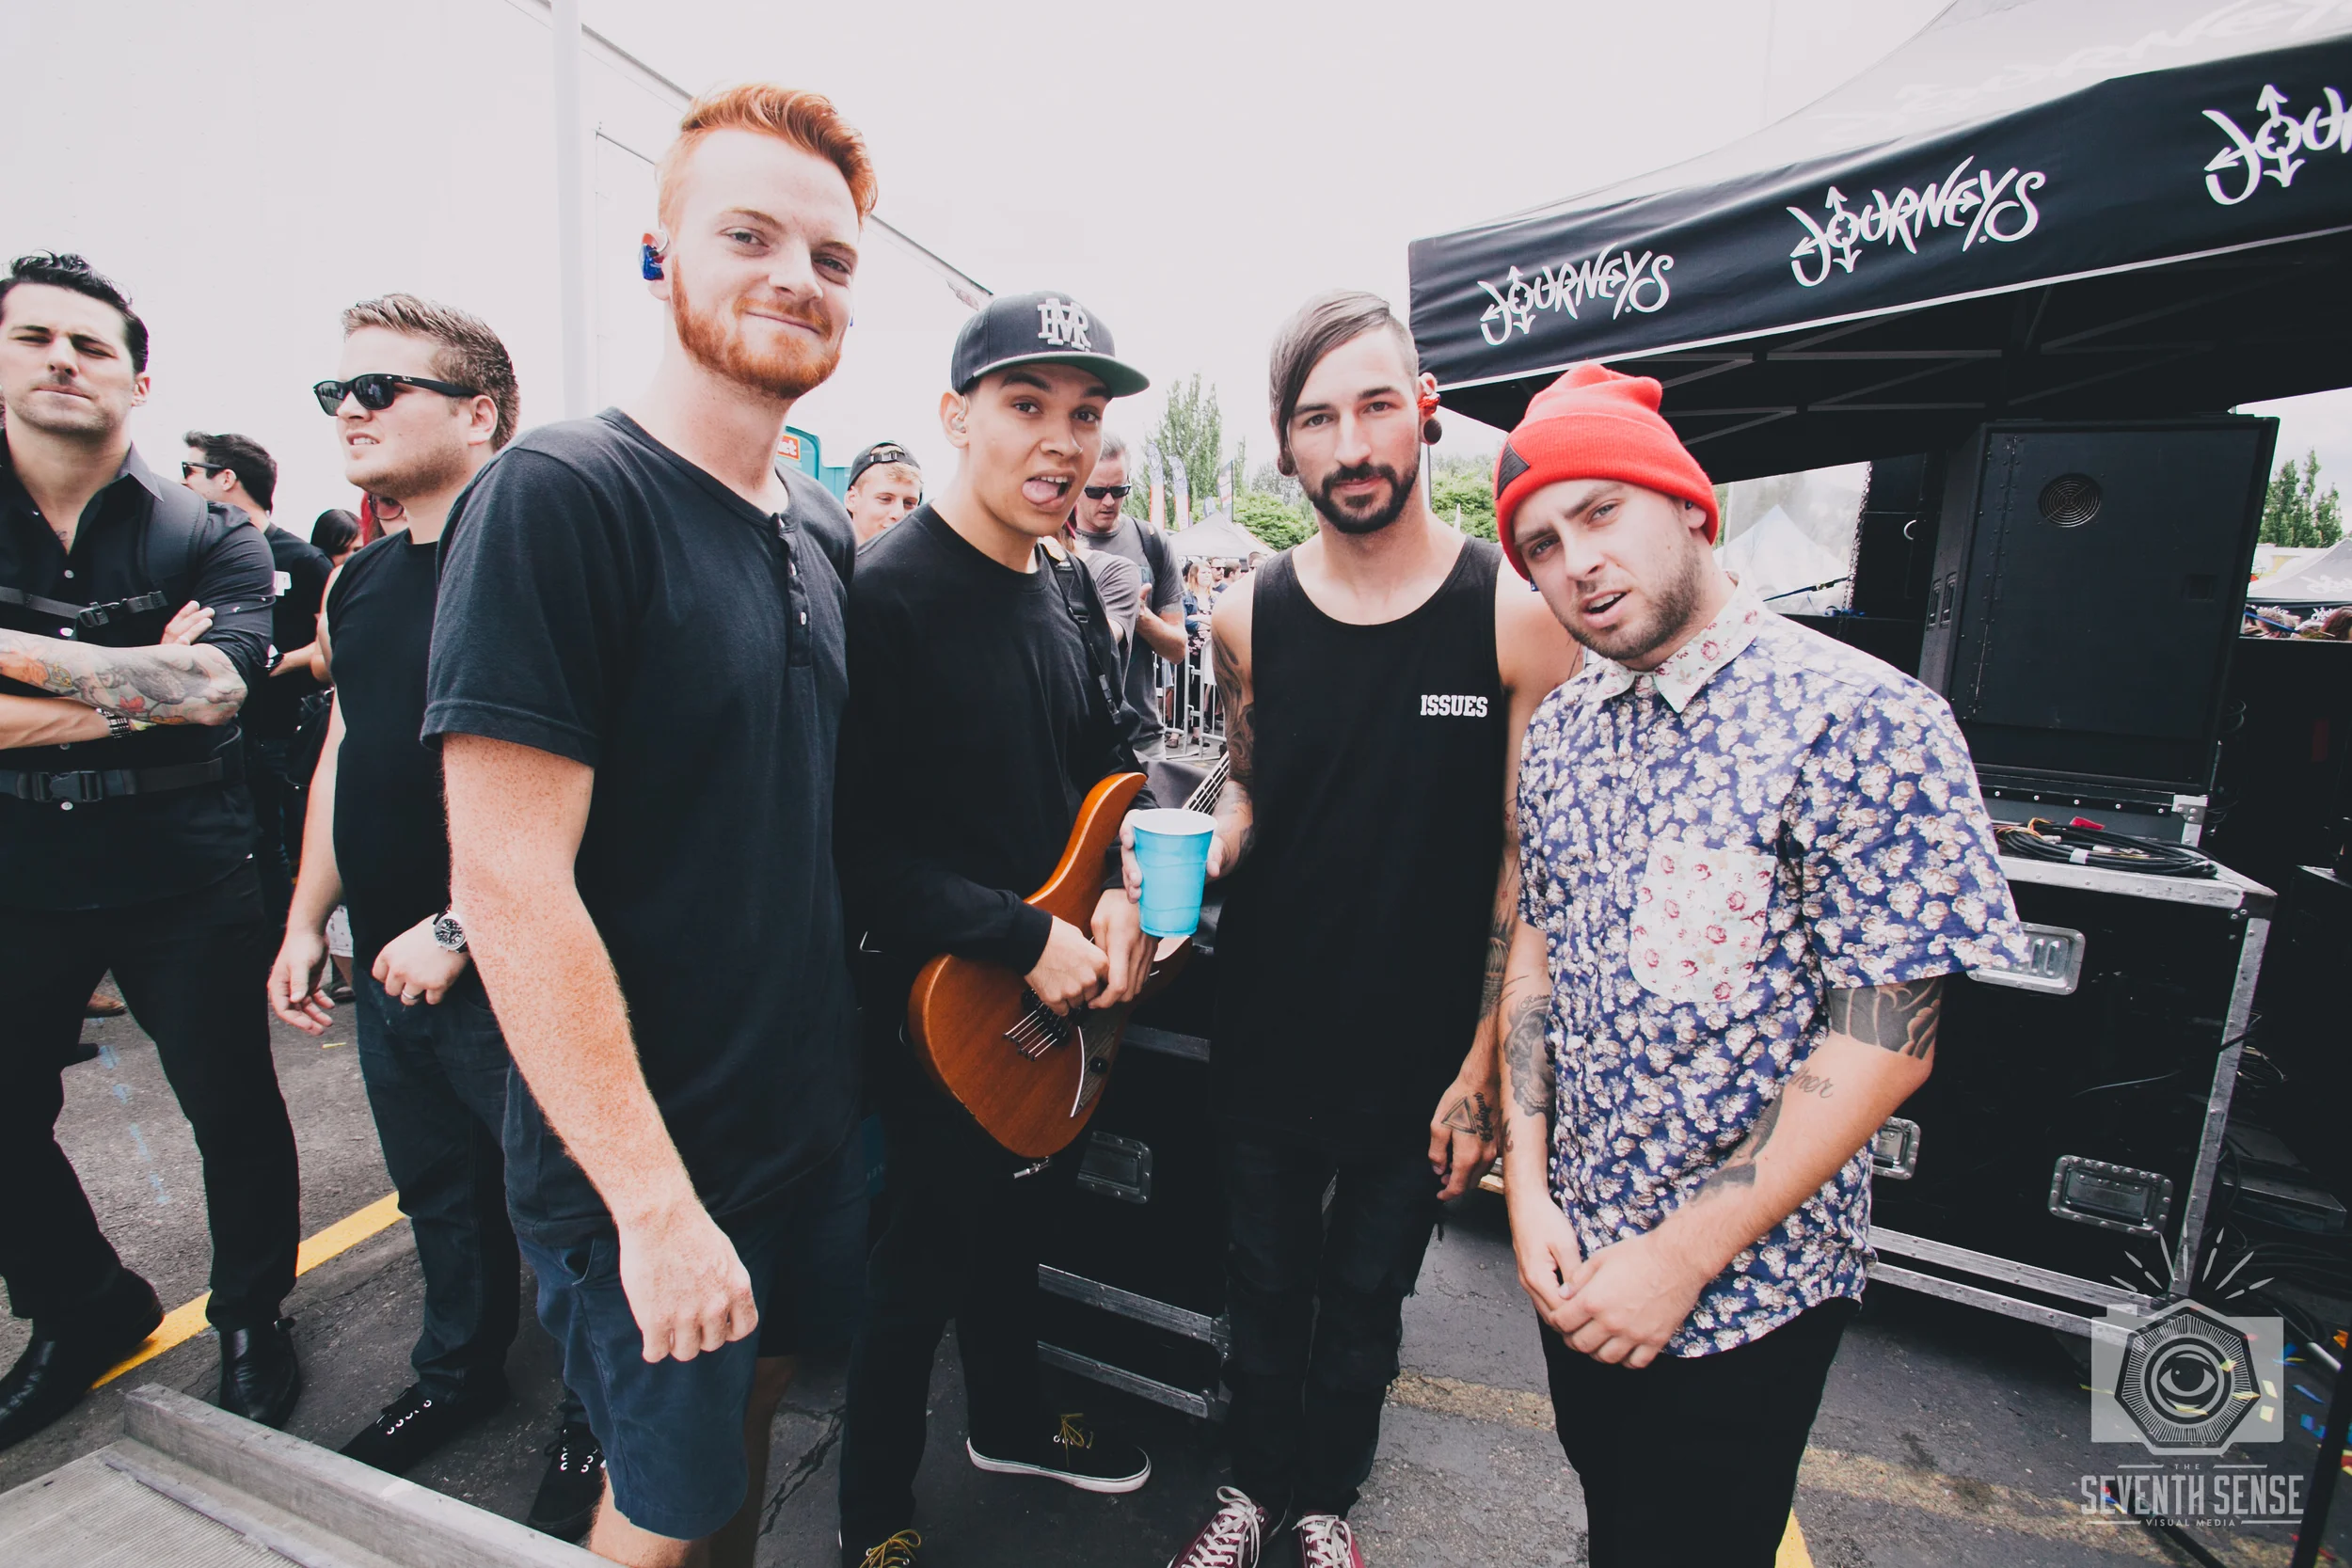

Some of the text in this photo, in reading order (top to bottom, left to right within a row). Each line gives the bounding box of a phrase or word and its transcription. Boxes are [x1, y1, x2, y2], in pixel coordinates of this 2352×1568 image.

[2201, 84, 2352, 205] JOU
[1787, 156, 2045, 287] JOURNEYS
[1479, 242, 1674, 346] JOURNEYS
[1420, 694, 1488, 718] ISSUES
